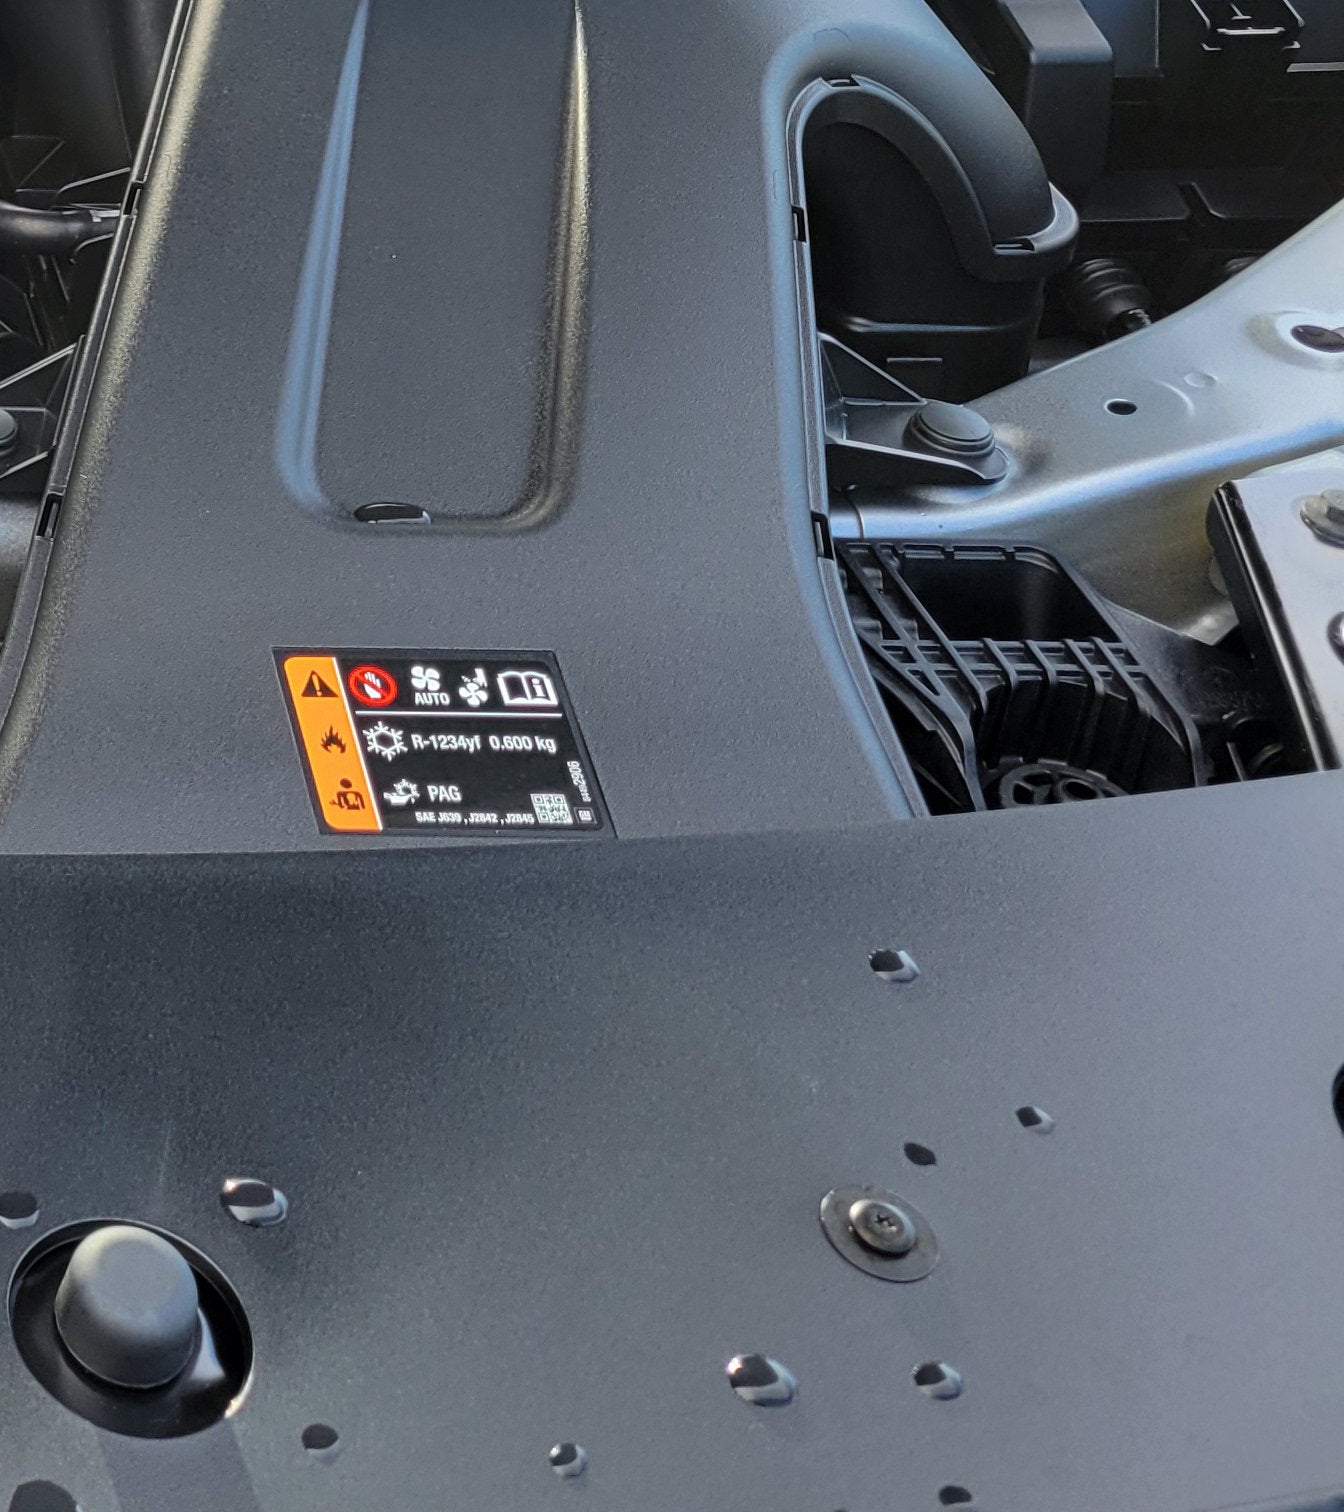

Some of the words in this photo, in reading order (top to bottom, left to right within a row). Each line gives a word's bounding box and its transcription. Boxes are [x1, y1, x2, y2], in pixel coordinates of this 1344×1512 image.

[414, 691, 451, 706] AUTO
[411, 734, 481, 754] R-1234yf
[488, 735, 533, 751] 0.600
[535, 736, 557, 755] kg
[427, 784, 462, 803] PAG
[414, 811, 436, 824] SAE
